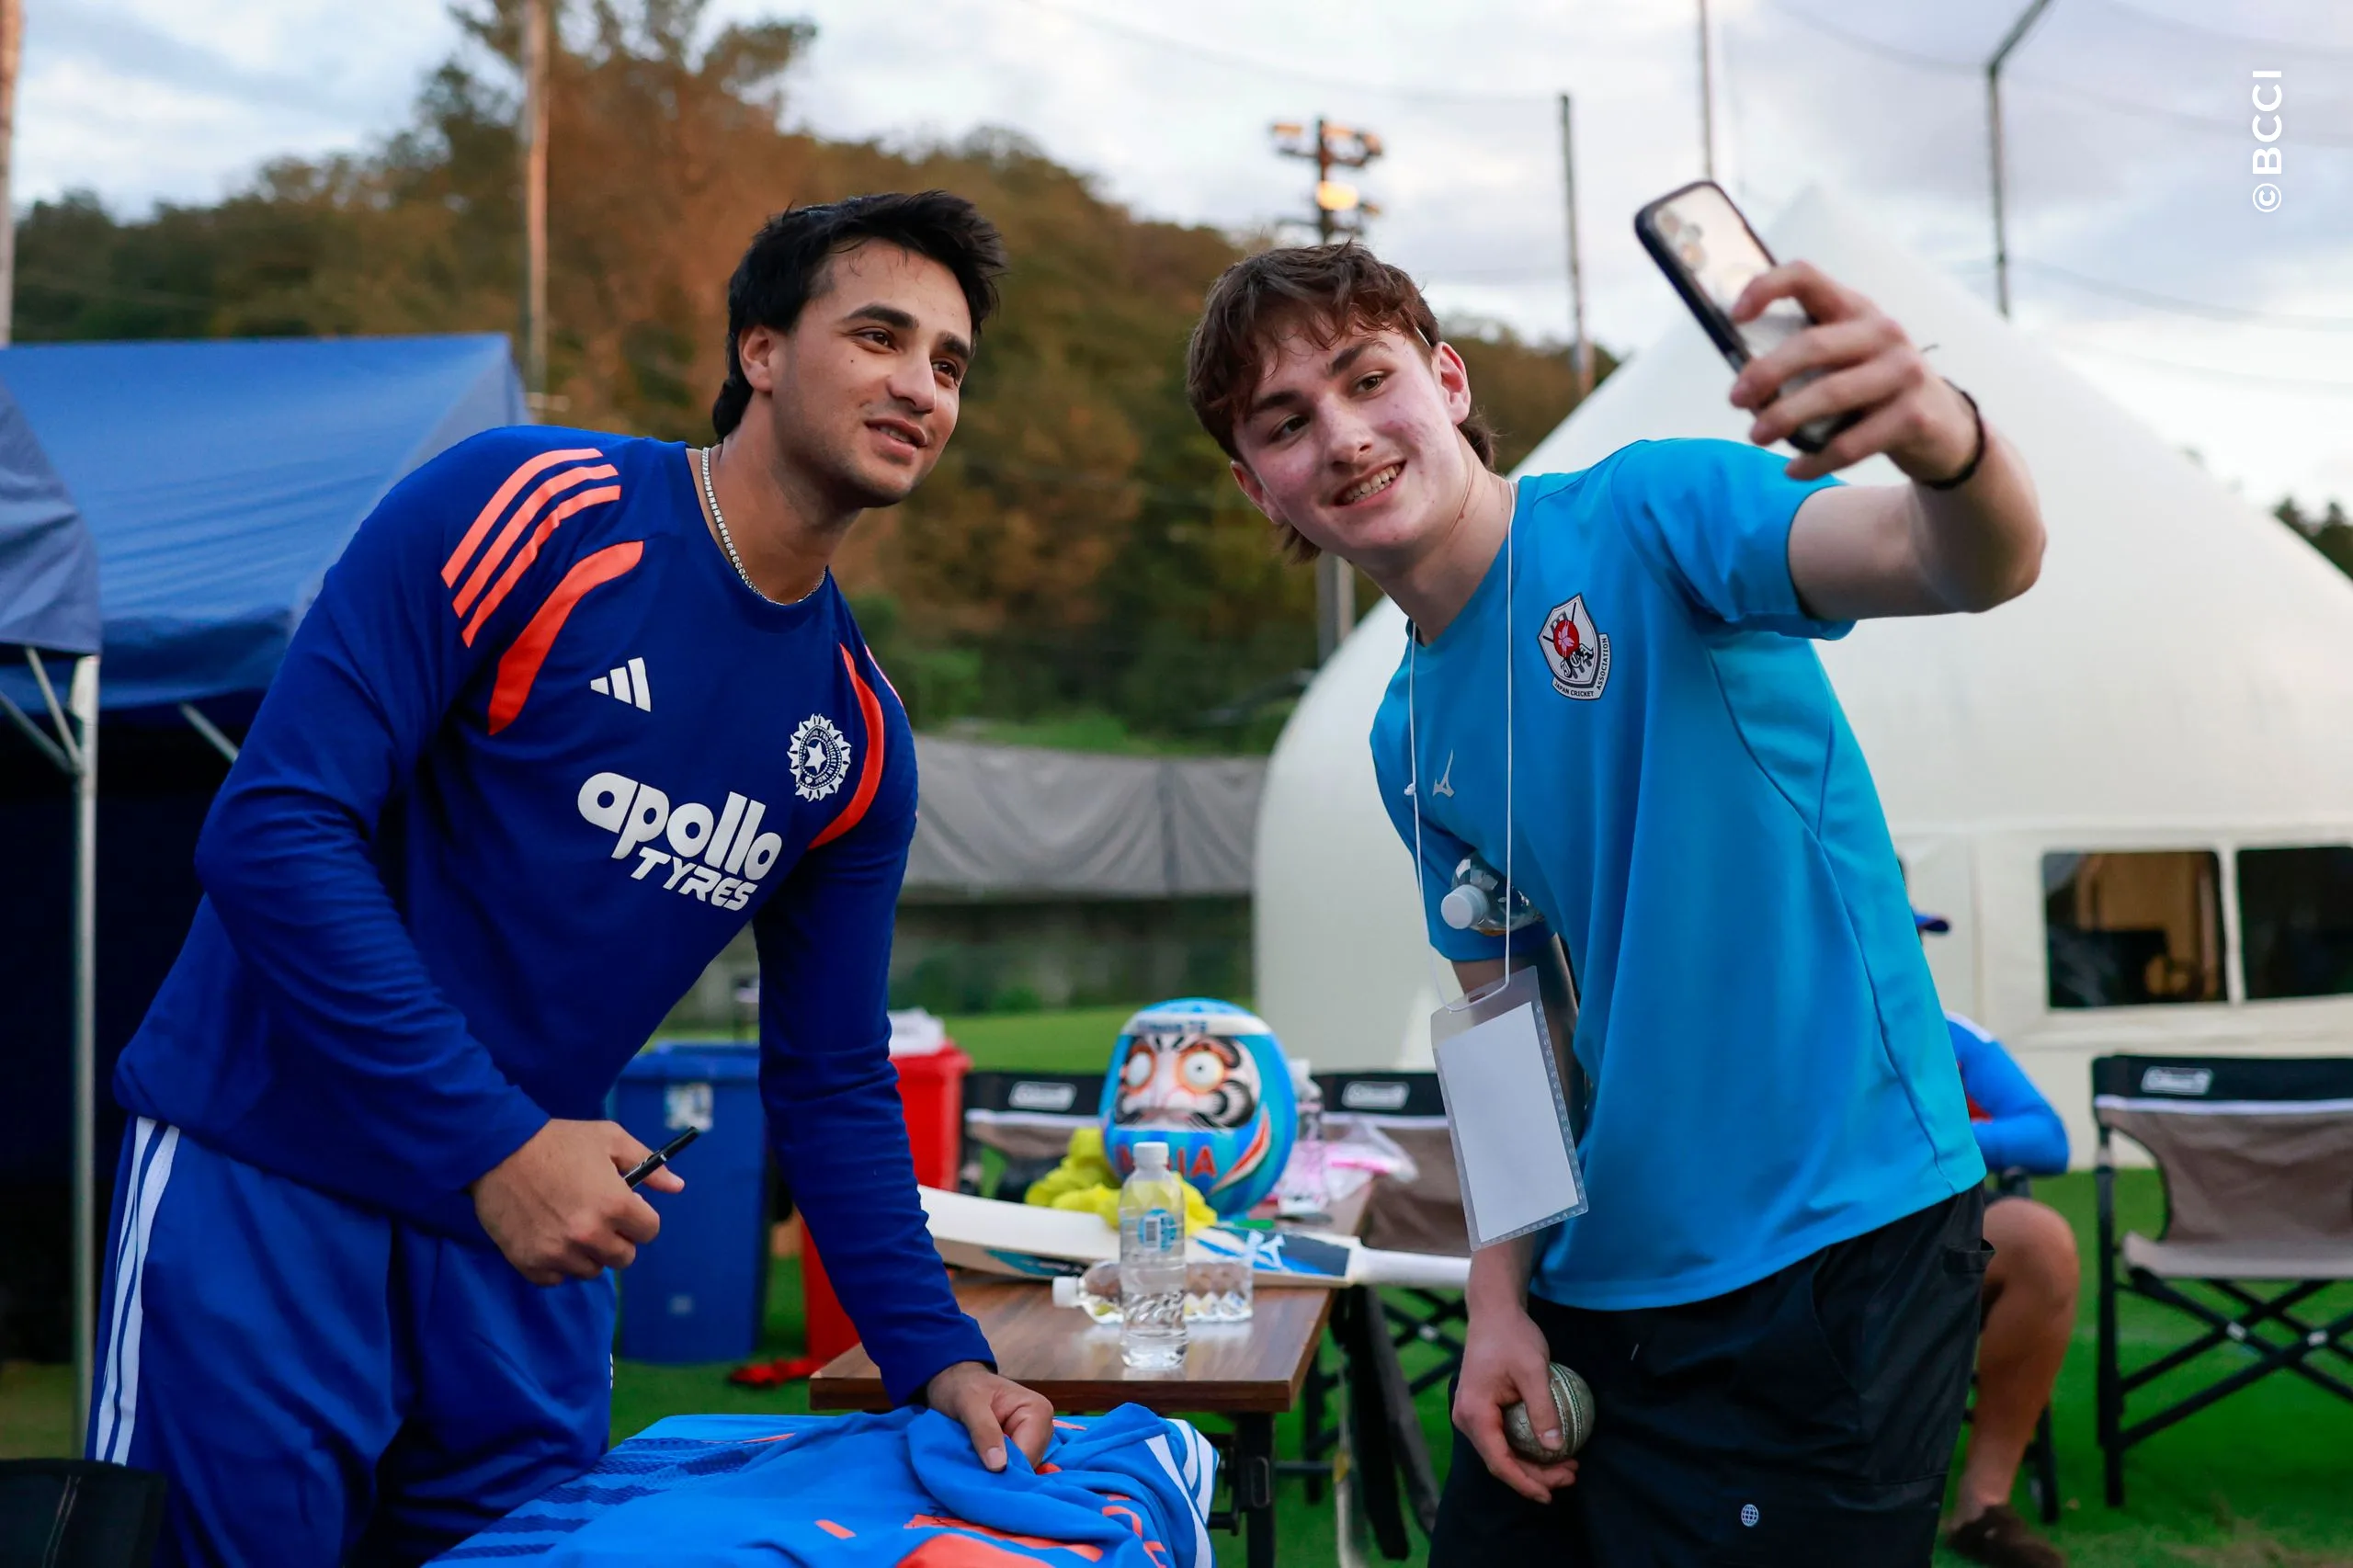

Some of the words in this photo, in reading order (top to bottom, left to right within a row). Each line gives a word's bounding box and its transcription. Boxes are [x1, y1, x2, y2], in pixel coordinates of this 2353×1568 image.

[1554, 680, 1570, 695] JAPAN
[1570, 689, 1594, 698] CRICKET
[1597, 637, 1609, 690] ASSOCIATION
[577, 772, 782, 881] apollo
[631, 846, 758, 911] TYRES
